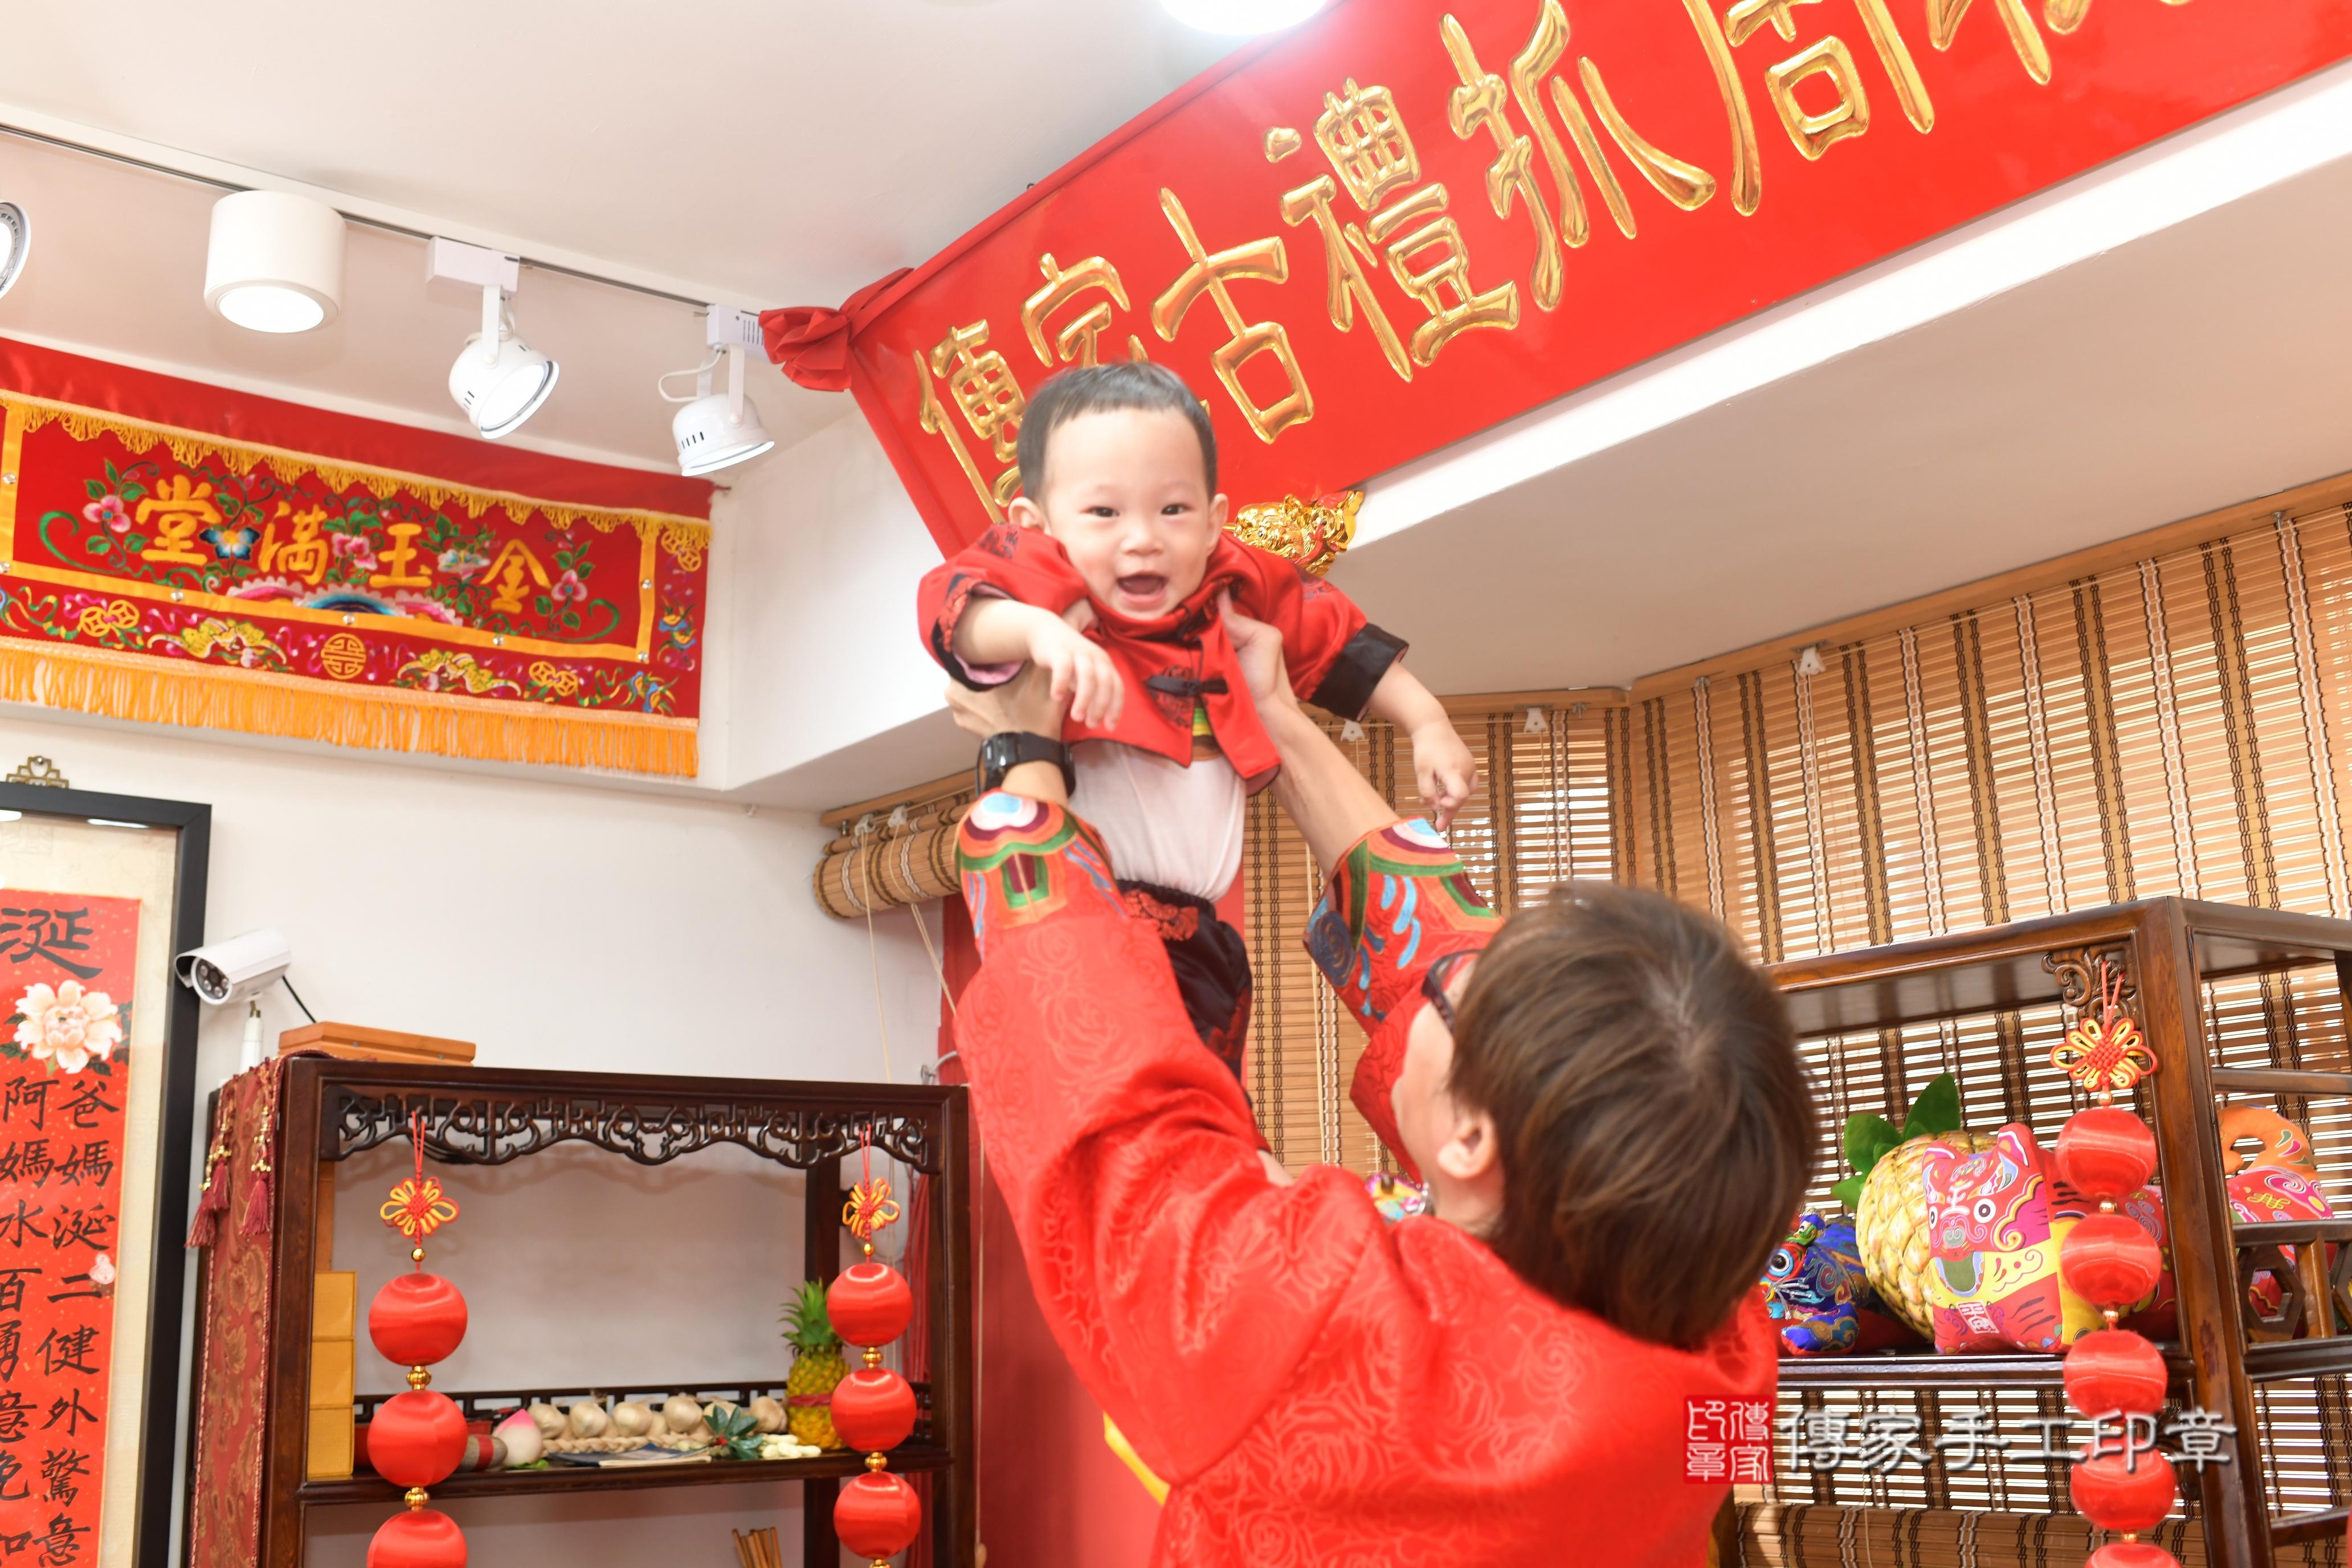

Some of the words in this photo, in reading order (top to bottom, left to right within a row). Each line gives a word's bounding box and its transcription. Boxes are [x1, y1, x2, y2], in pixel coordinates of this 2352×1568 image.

[913, 0, 2097, 524] 傳古禮抓周
